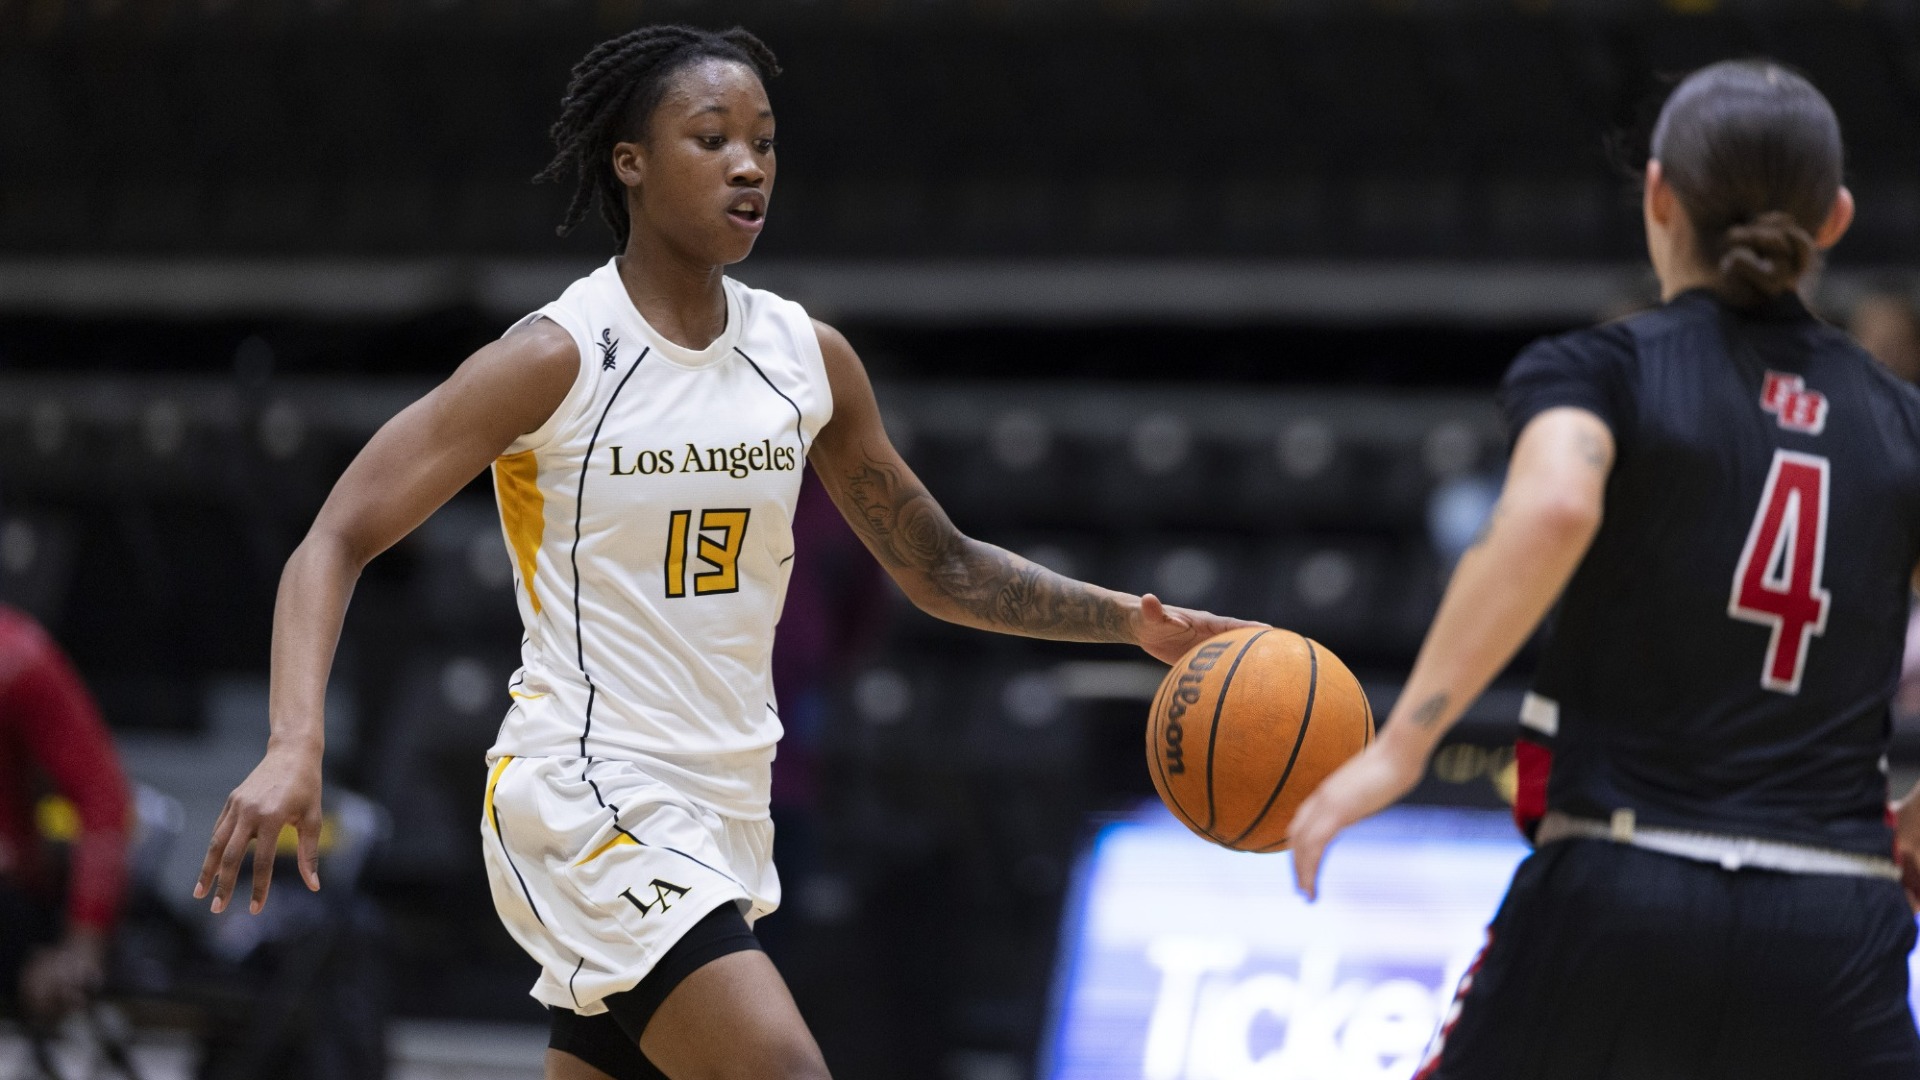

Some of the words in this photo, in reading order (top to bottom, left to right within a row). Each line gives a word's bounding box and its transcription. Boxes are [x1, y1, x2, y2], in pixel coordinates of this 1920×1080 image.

[609, 446, 674, 475] Los
[679, 439, 795, 479] Angeles
[664, 508, 751, 598] 13
[1727, 448, 1831, 694] 4
[1165, 640, 1235, 776] Wilson
[617, 878, 693, 919] LA
